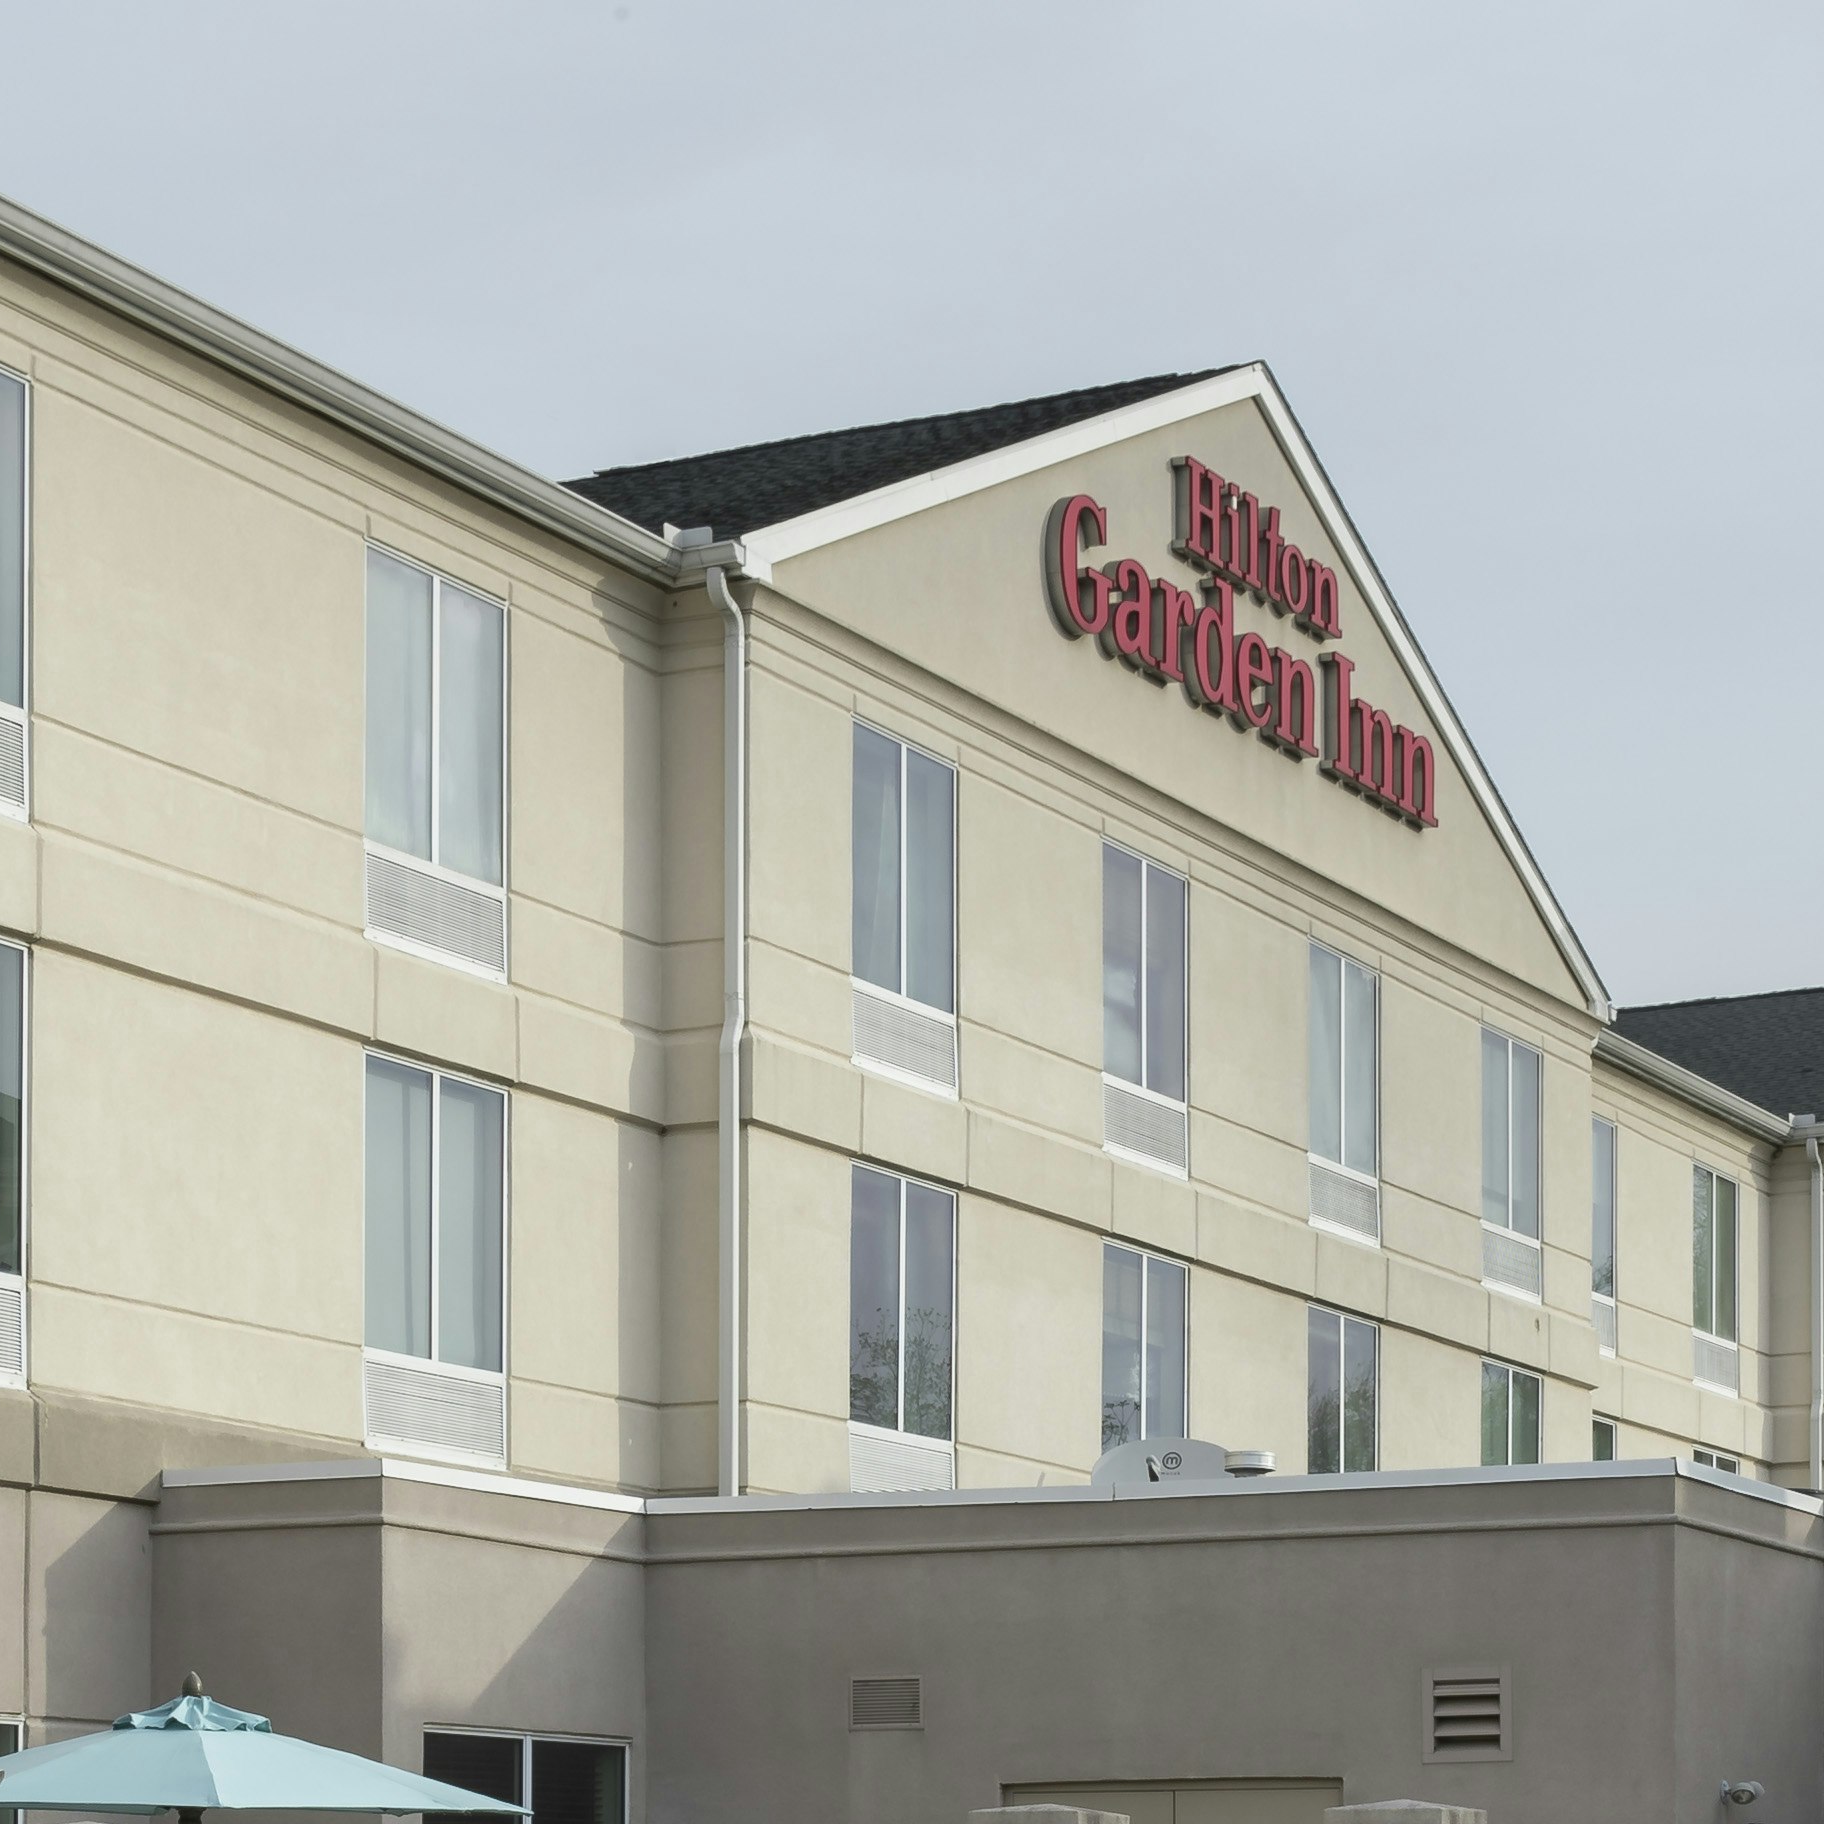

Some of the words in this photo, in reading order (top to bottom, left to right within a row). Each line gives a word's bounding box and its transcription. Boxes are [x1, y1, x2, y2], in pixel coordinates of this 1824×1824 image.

[1056, 495, 1319, 758] Garden
[1331, 651, 1439, 828] Inn
[1182, 455, 1342, 638] Hilton
